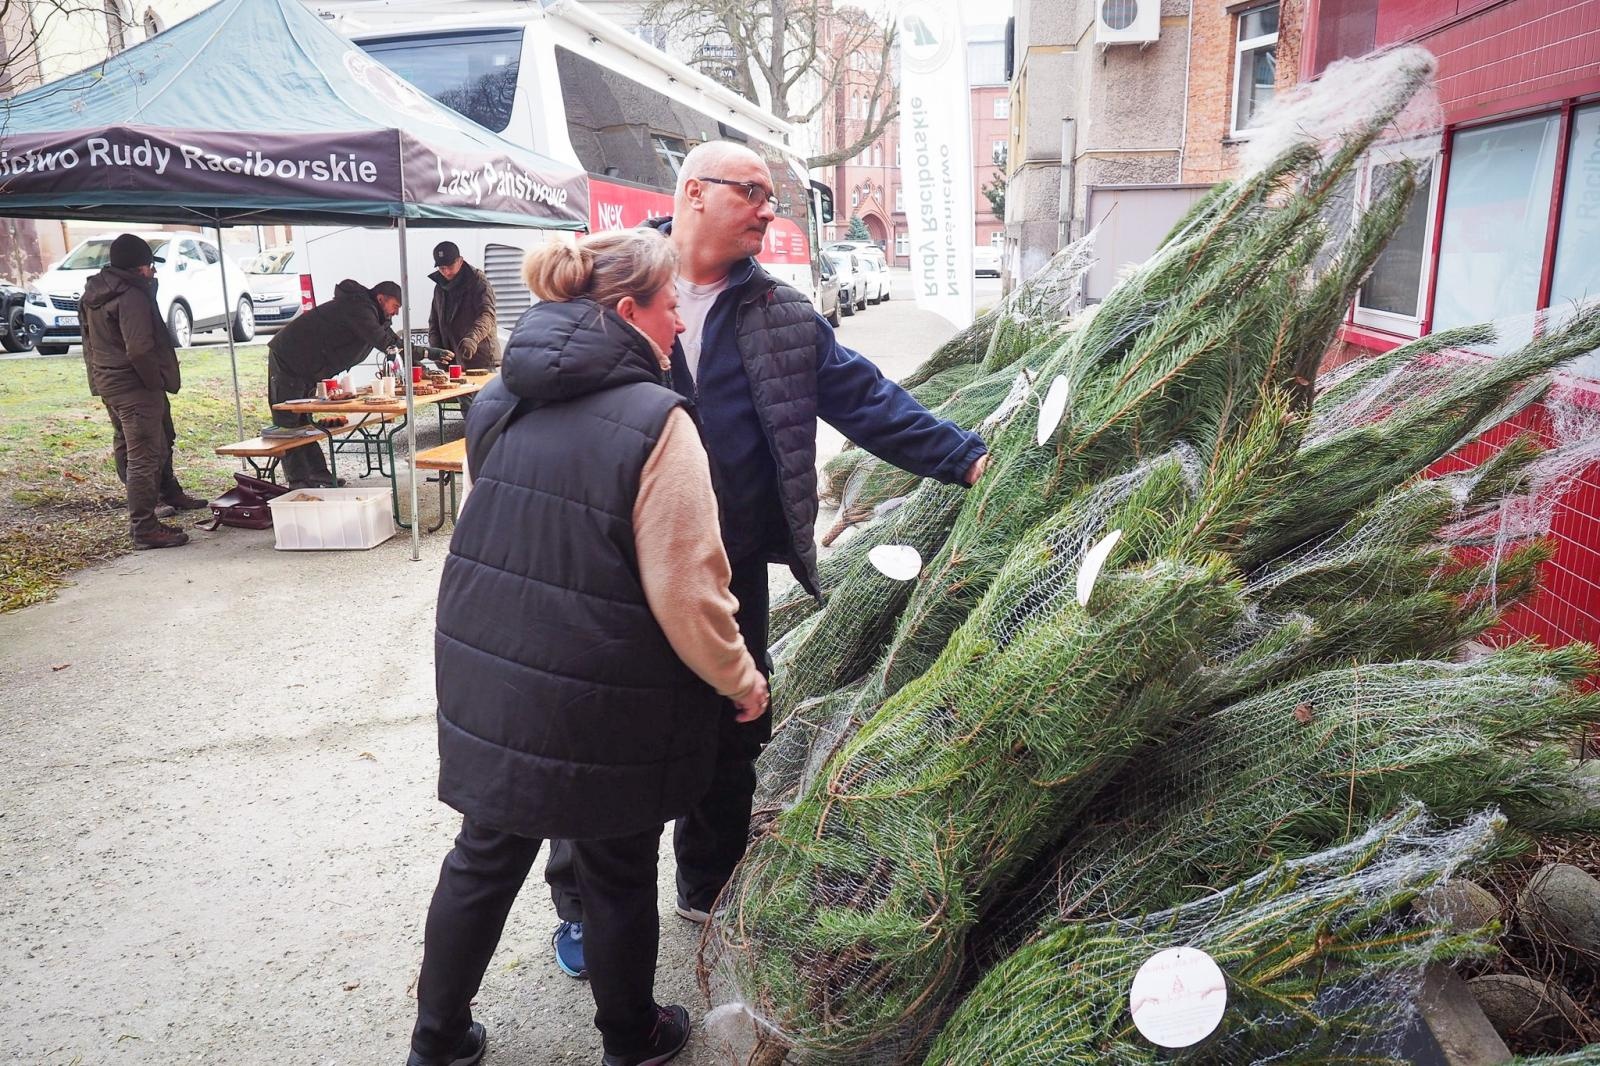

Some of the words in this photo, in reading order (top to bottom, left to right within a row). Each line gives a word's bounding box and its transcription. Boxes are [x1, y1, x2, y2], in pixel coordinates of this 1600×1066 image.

[0, 149, 79, 176] ictwo
[87, 137, 171, 174] Rudy
[184, 145, 378, 183] Raciborskie
[437, 155, 482, 205] Lasy
